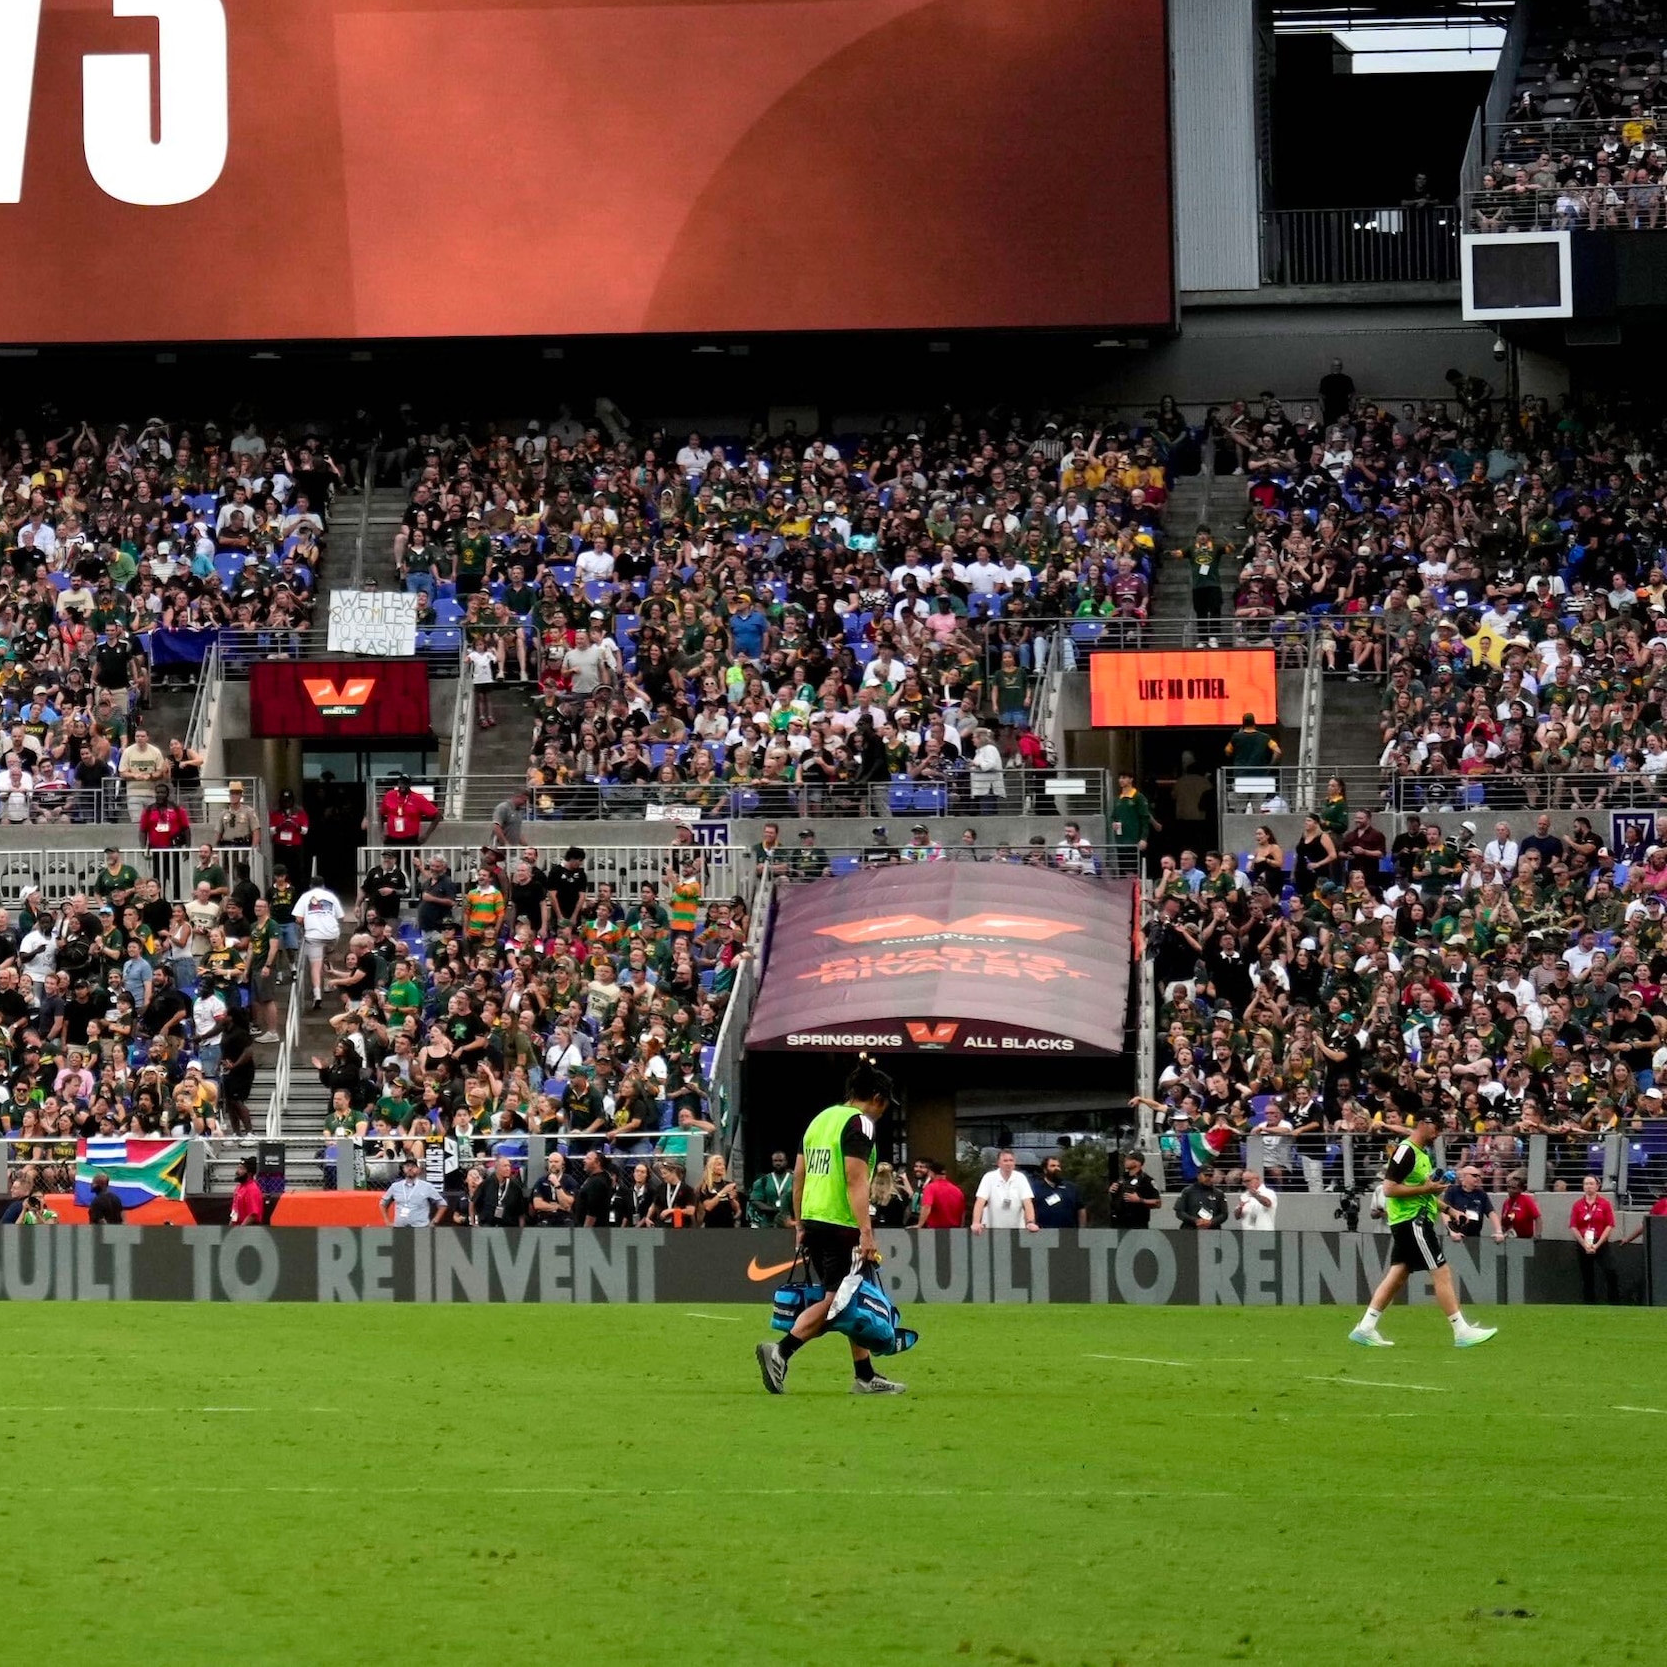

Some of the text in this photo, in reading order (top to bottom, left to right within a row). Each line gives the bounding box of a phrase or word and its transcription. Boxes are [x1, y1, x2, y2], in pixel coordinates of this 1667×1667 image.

[339, 591, 417, 610] WE FLEW
[332, 606, 372, 624] 8000
[331, 622, 350, 639] TO
[1139, 679, 1229, 700] LIKE NO OTHER.
[787, 1035, 903, 1047] SPRINGBOKS
[963, 1037, 1074, 1050] ALL BLACKS
[183, 1226, 280, 1302] TO
[883, 1228, 1061, 1304] BUILT
[1079, 1229, 1177, 1304] TO
